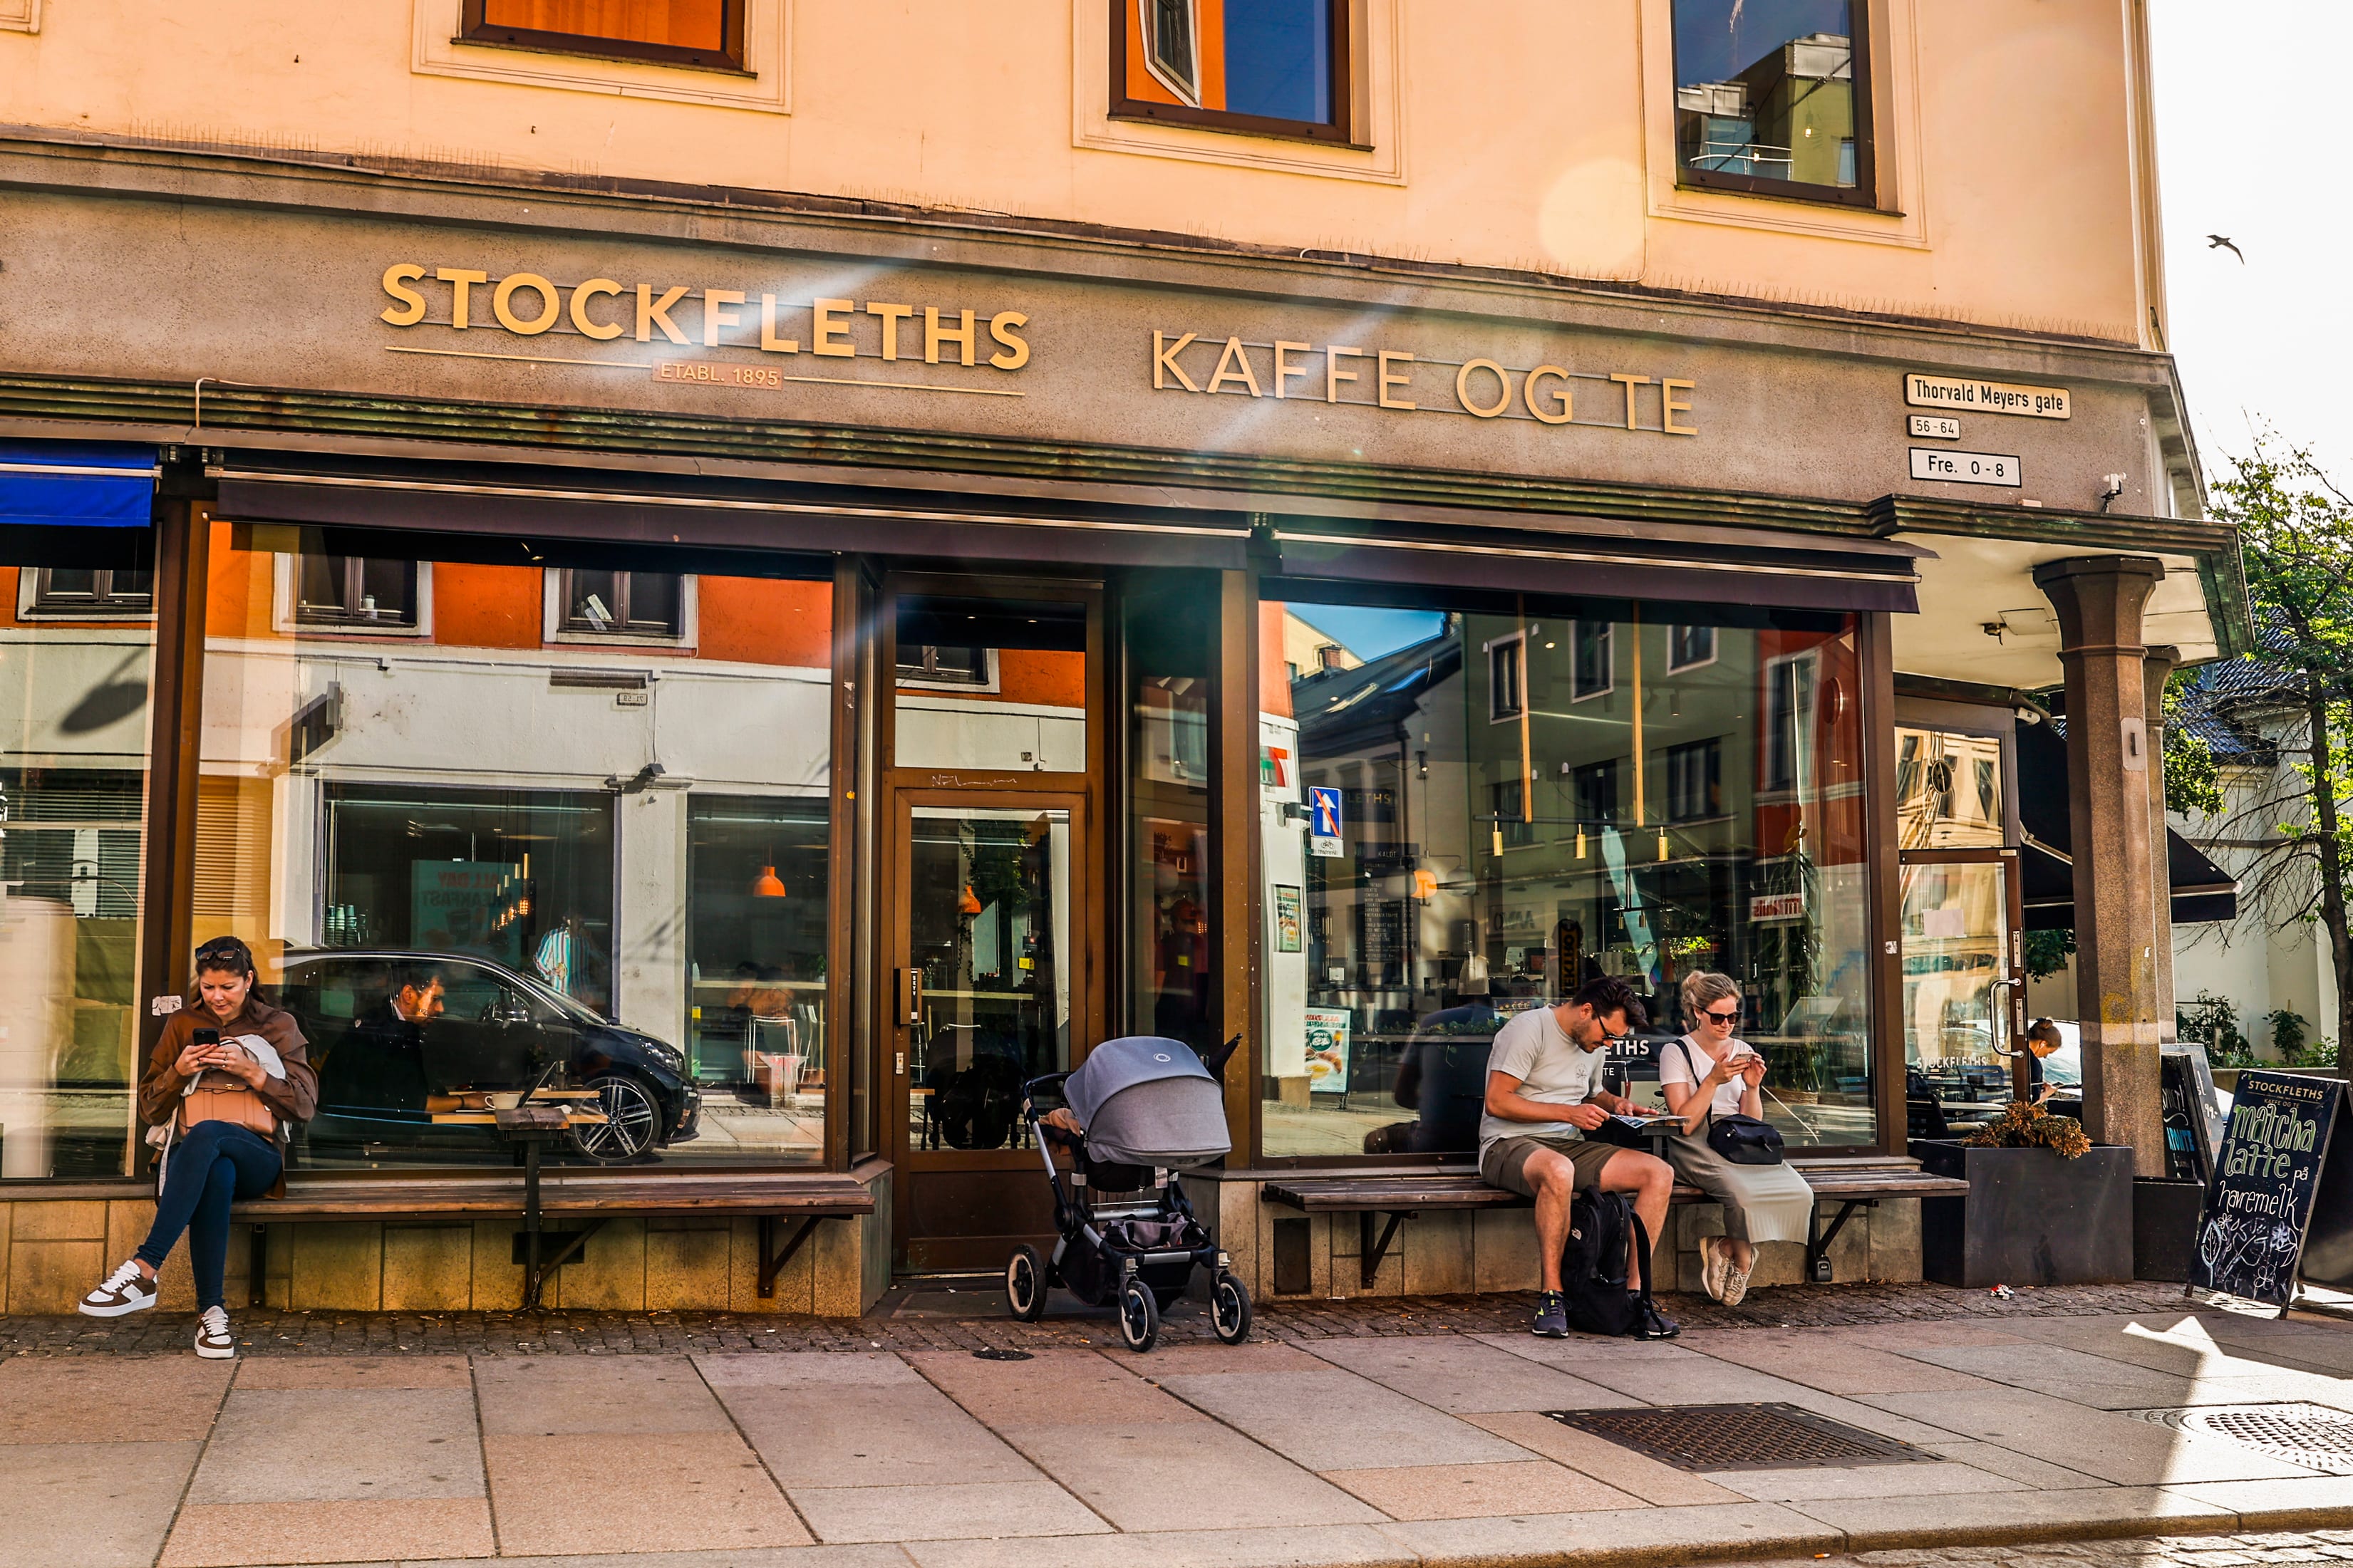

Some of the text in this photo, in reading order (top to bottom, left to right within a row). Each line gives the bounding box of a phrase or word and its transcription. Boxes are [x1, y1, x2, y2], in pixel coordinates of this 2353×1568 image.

[379, 263, 1030, 370] STOCKFLETHS
[661, 363, 778, 386] ETABL. 1895
[1152, 330, 1699, 435] KAFFE OG TE
[1915, 379, 2064, 413] Thorvald Meyers gate
[1928, 455, 1958, 474] Fre.
[2248, 1080, 2324, 1100] STOCKFLETHS
[2231, 1104, 2317, 1153] matcha
[2224, 1138, 2291, 1178] latte
[2292, 1166, 2309, 1188] på
[2218, 1180, 2301, 1231] havremelk
